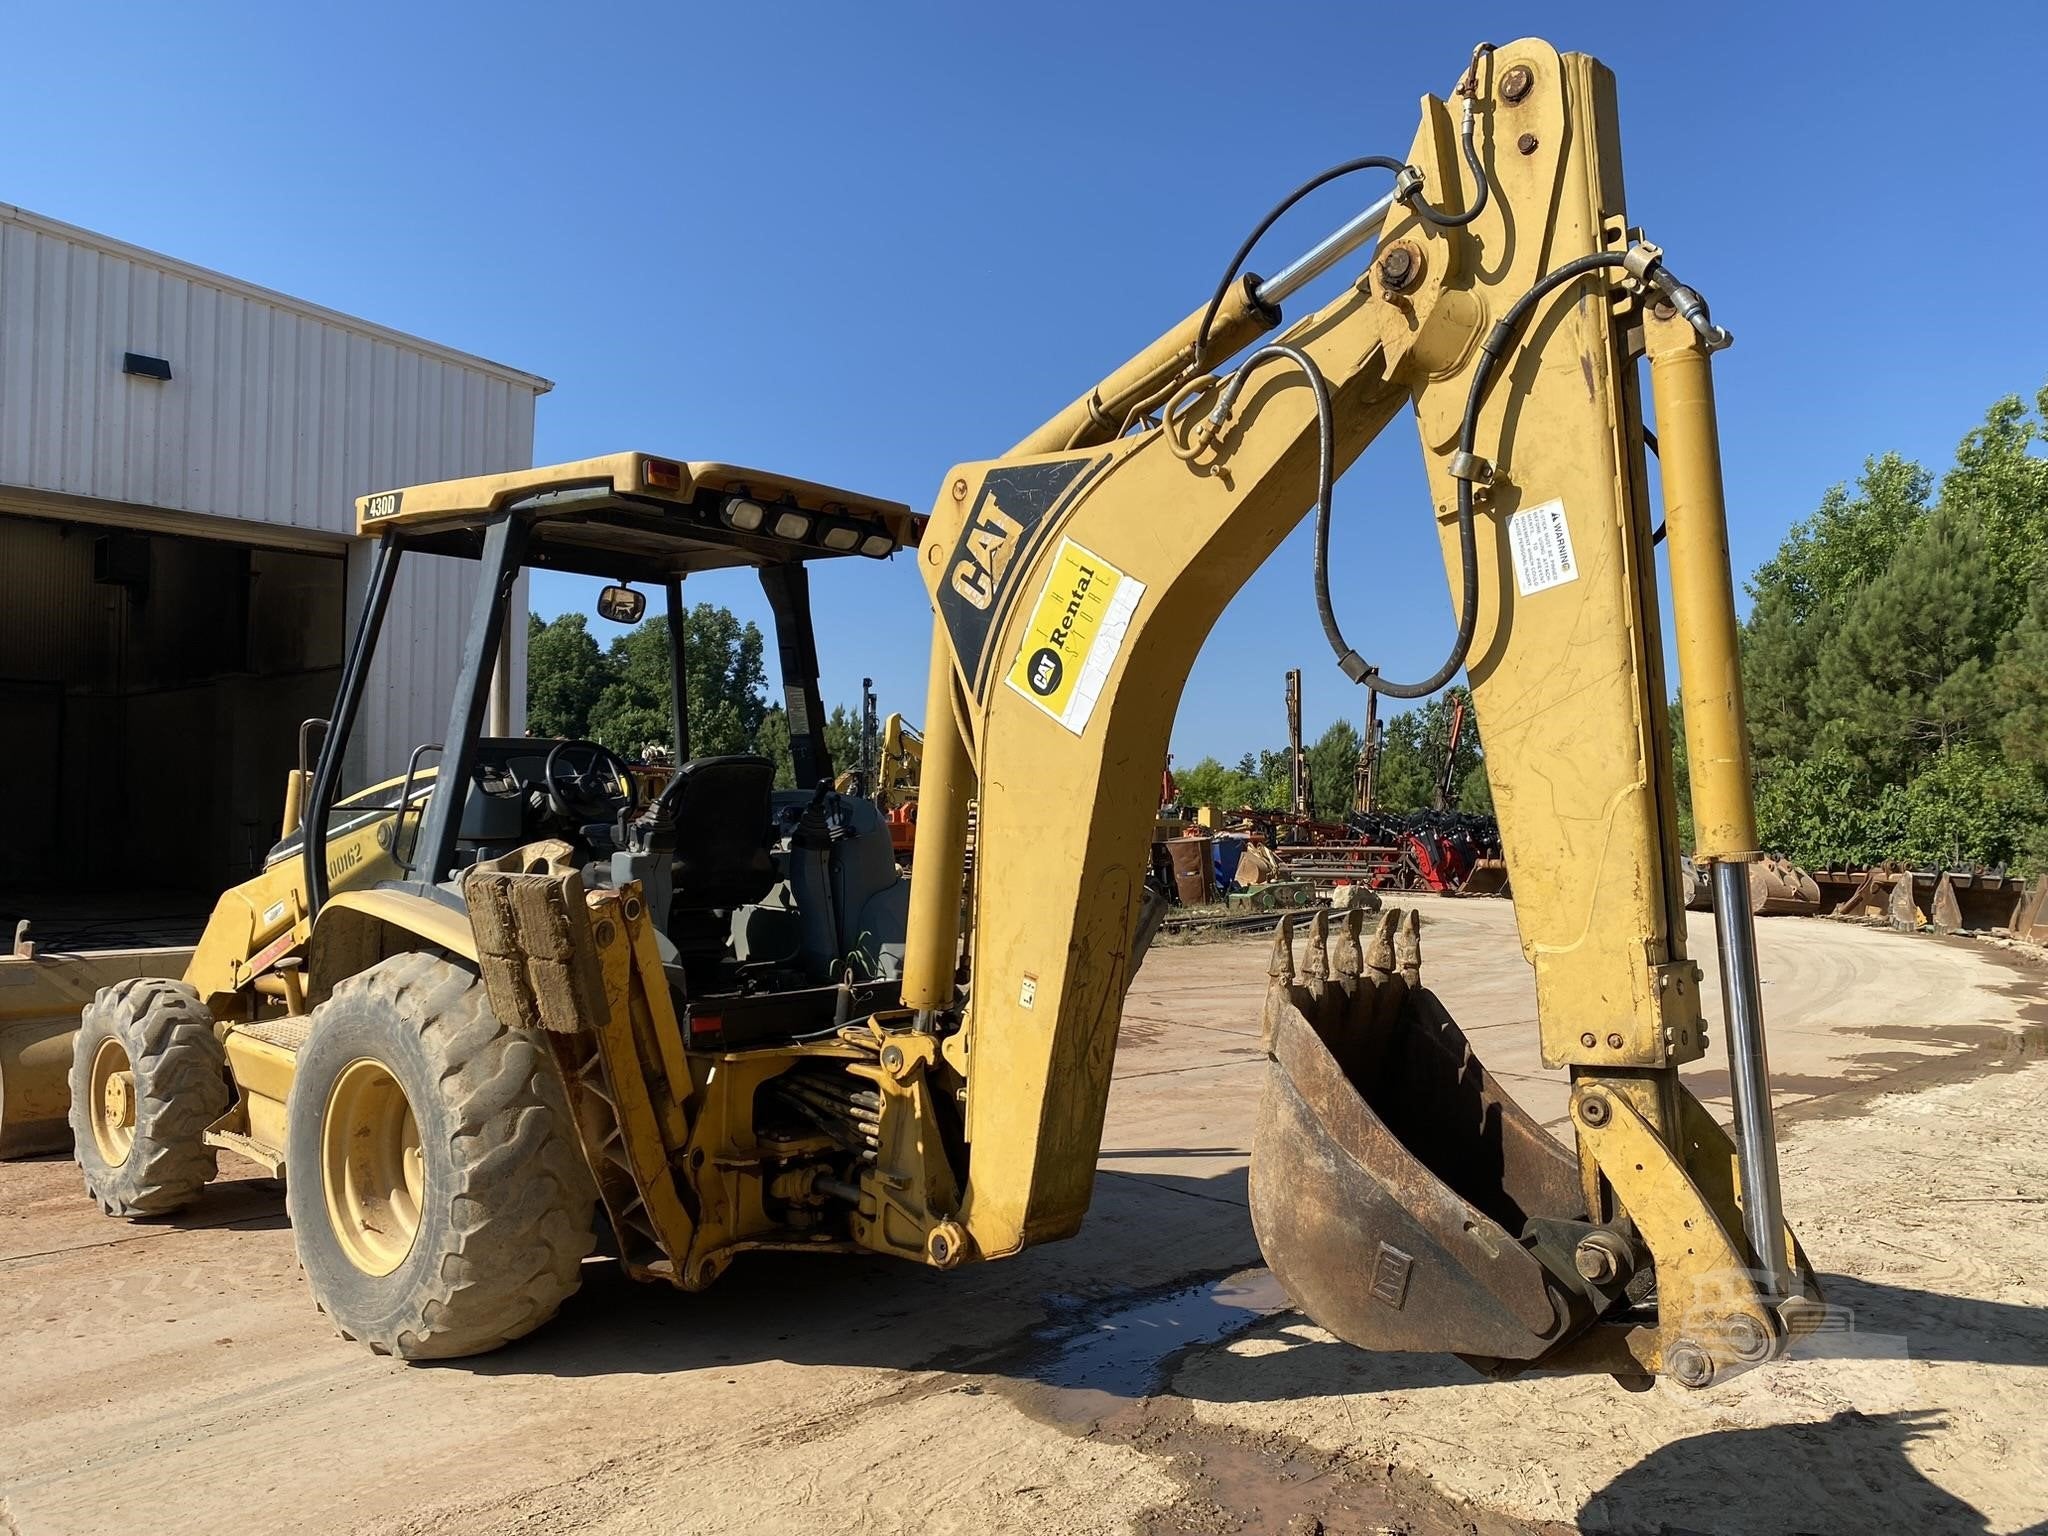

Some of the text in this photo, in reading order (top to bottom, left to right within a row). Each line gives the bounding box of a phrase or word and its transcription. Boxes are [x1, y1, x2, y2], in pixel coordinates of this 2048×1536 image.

[370, 495, 395, 516] 430D
[951, 489, 1024, 610] CAT
[1554, 522, 1569, 571] WARNING
[1033, 569, 1095, 690] CAT Rental
[1065, 575, 1110, 658] STORE
[327, 843, 362, 882] 00162
